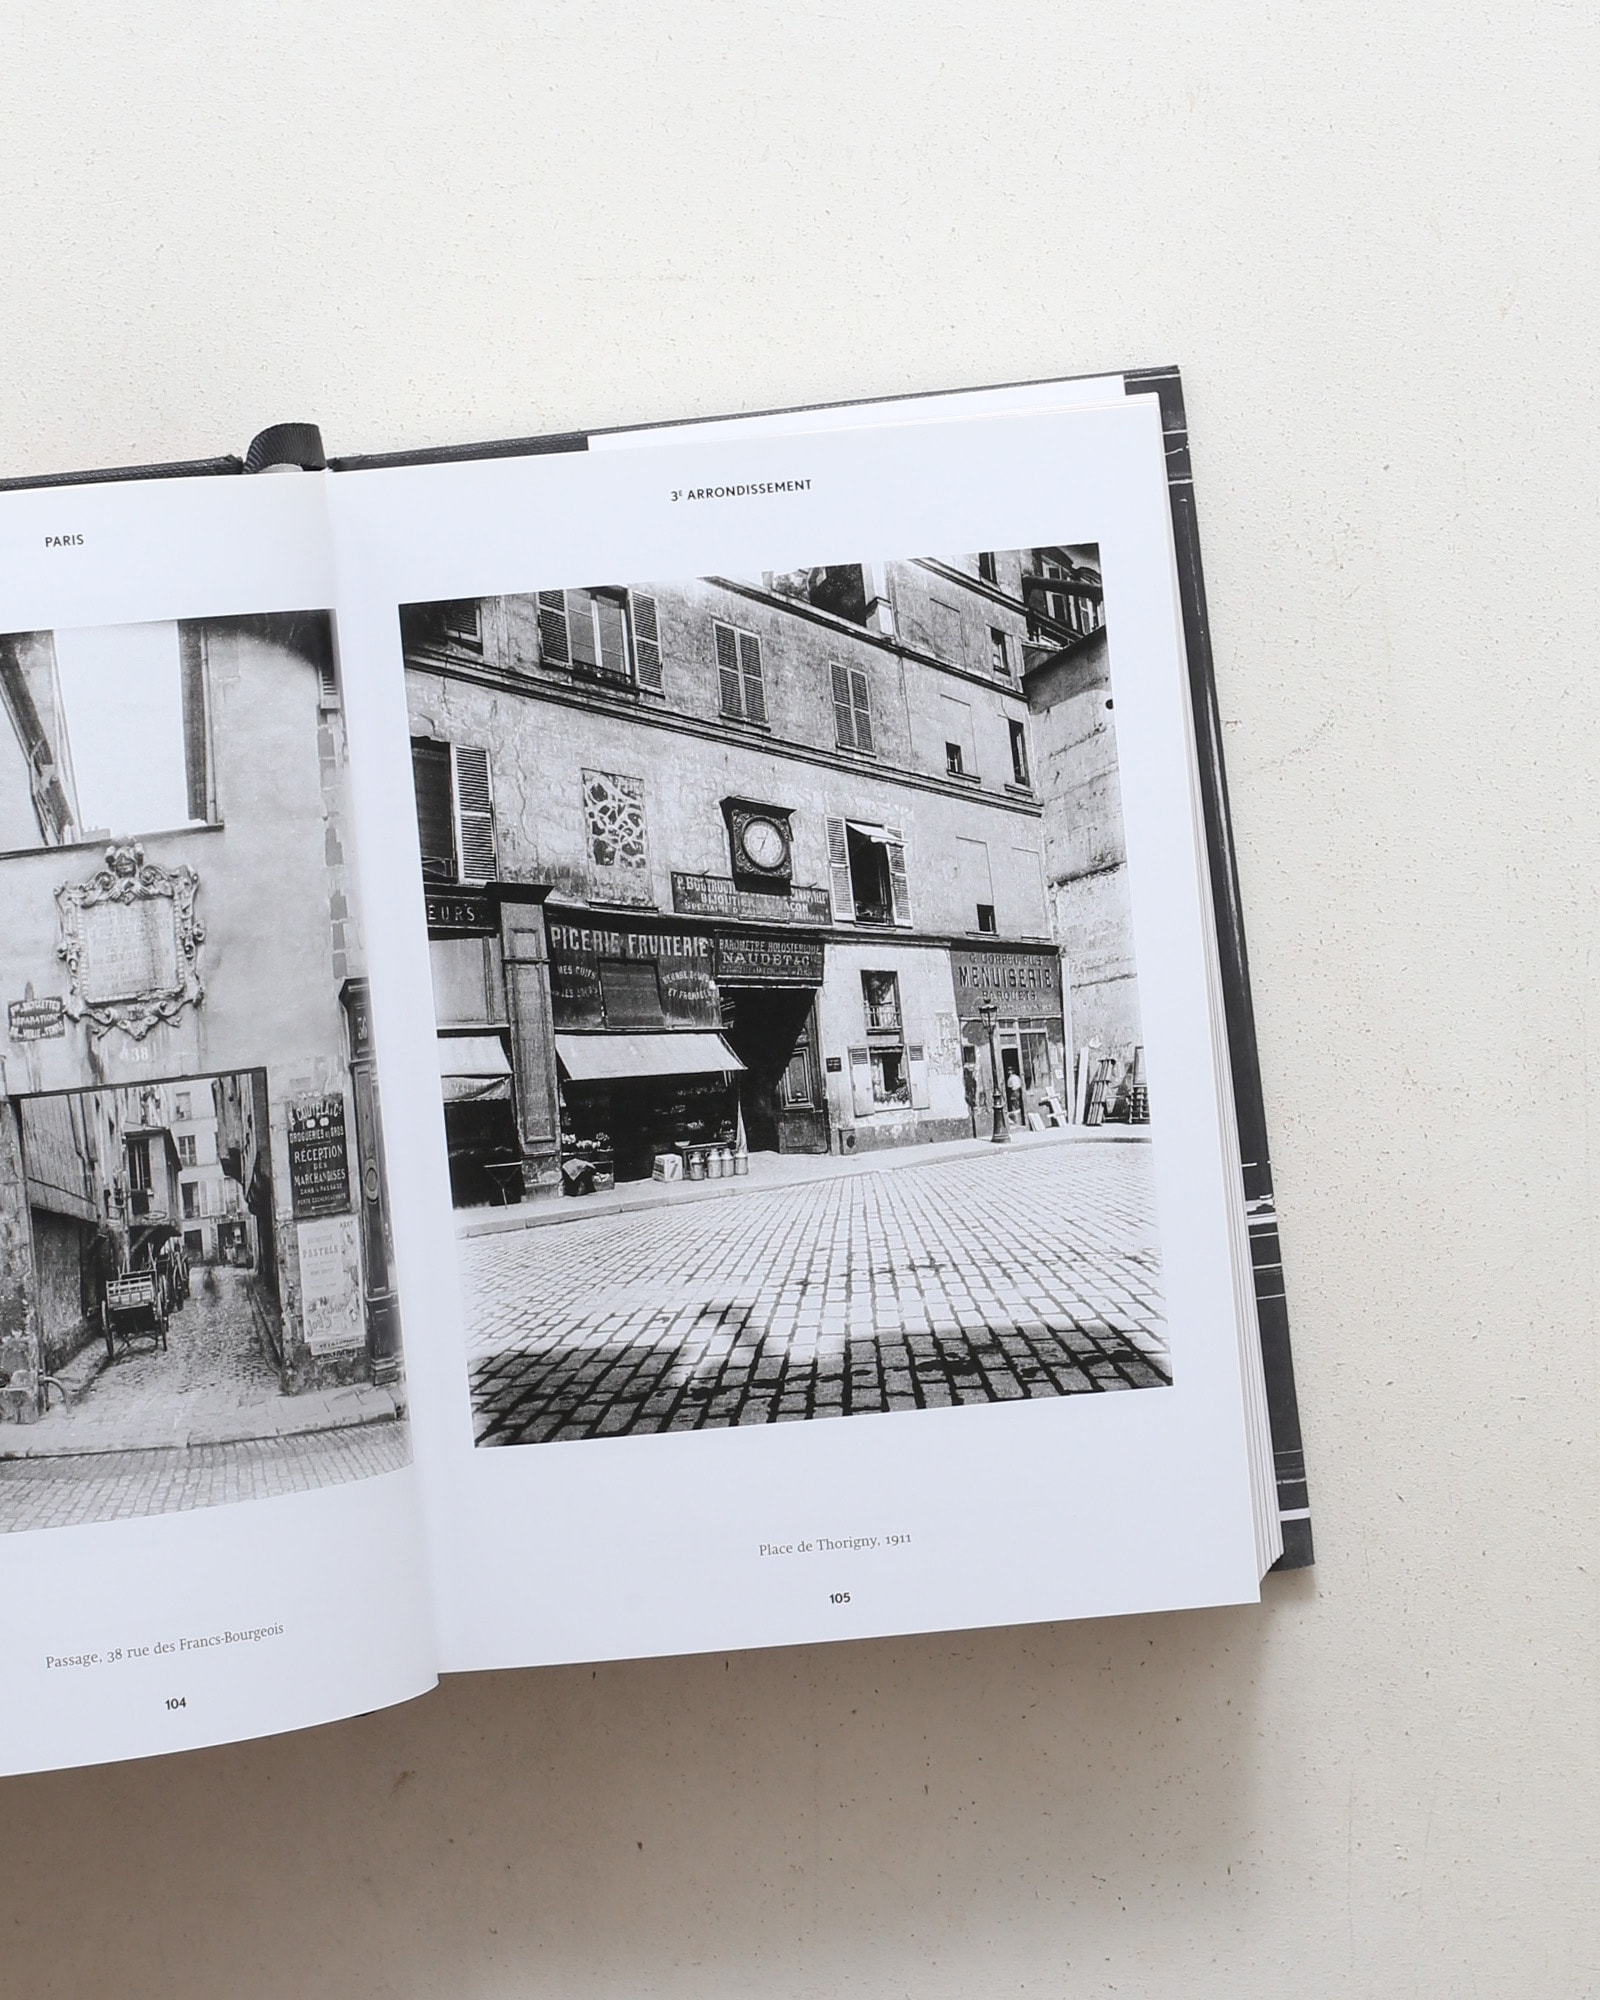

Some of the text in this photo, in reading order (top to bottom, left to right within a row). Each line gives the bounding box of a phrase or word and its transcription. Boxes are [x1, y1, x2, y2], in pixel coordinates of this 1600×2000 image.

[687, 479, 811, 501] ARRONDISSEMENT
[45, 534, 84, 548] PARIS
[628, 933, 709, 958] FRUITERIE
[722, 952, 793, 967] NAUDET
[959, 966, 1054, 989] MENUISERIE
[294, 1168, 346, 1187] MARCHANDISES
[759, 1534, 912, 1556] Place de Thorigny, 1911
[829, 1592, 851, 1604] 105
[46, 1622, 284, 1668] Passage, 38 rue des Francs-Bourgeois
[165, 1697, 187, 1710] 104
